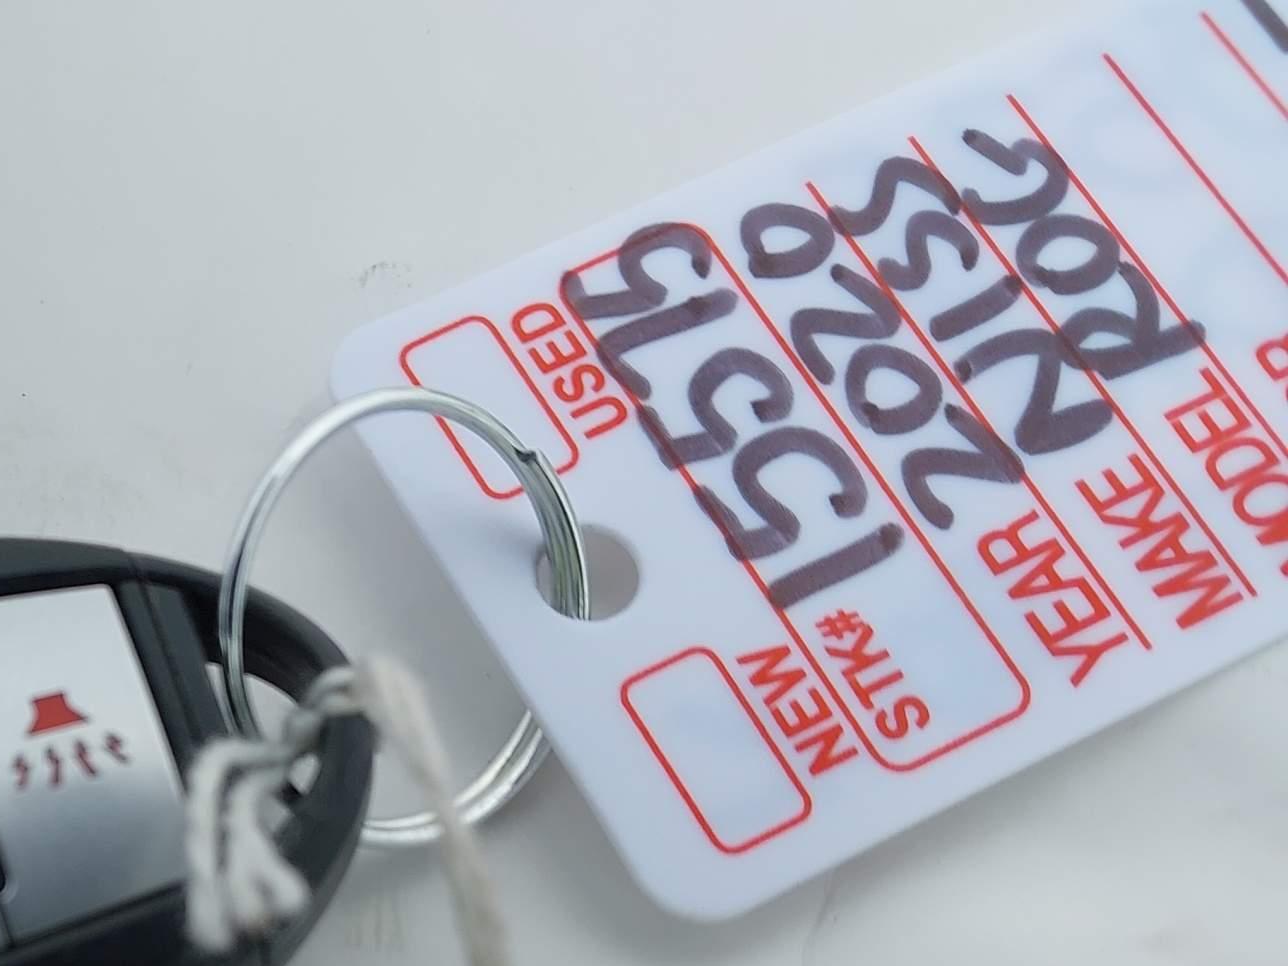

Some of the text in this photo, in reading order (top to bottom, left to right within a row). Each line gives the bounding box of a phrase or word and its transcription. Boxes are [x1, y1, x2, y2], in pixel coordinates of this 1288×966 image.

[829, 155, 1115, 455] NISS
[961, 128, 1207, 380] ROG
[511, 301, 628, 439] USED
[560, 222, 904, 608] 15575
[739, 202, 1024, 531] 2020
[976, 510, 1129, 688] YEAR
[1075, 451, 1244, 631] MAKE
[737, 644, 861, 777] NEW
[814, 608, 930, 742] STK#
